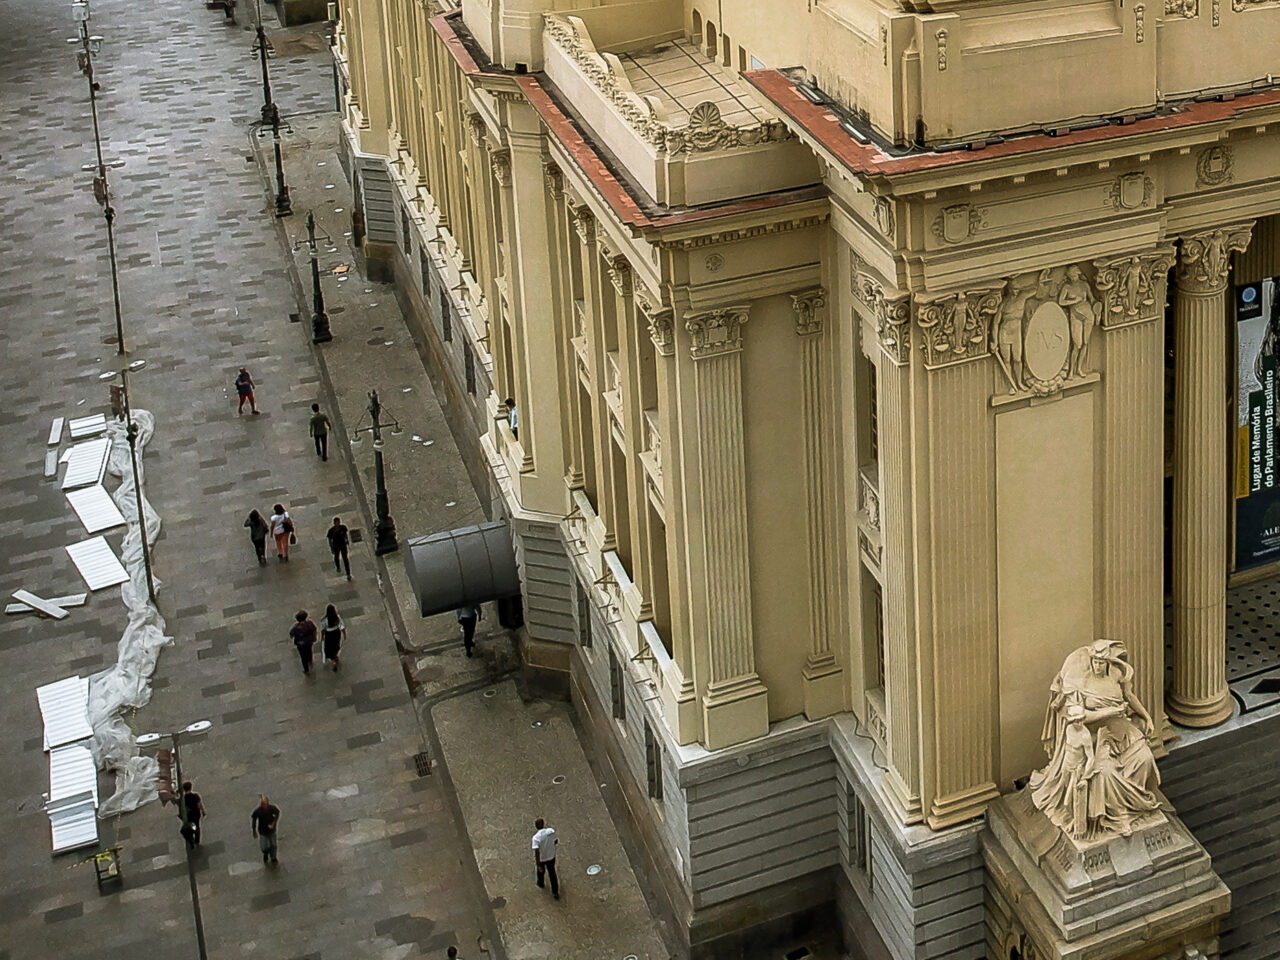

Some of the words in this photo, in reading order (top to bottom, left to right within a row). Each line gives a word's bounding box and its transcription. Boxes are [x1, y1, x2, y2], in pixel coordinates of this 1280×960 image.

[1264, 370, 1274, 415] Brasileiro
[1251, 406, 1261, 449] Memória
[1264, 416, 1274, 473] Parlamento
[1251, 450, 1261, 462] de
[1251, 464, 1262, 492] Lugar
[1264, 475, 1274, 487] do
